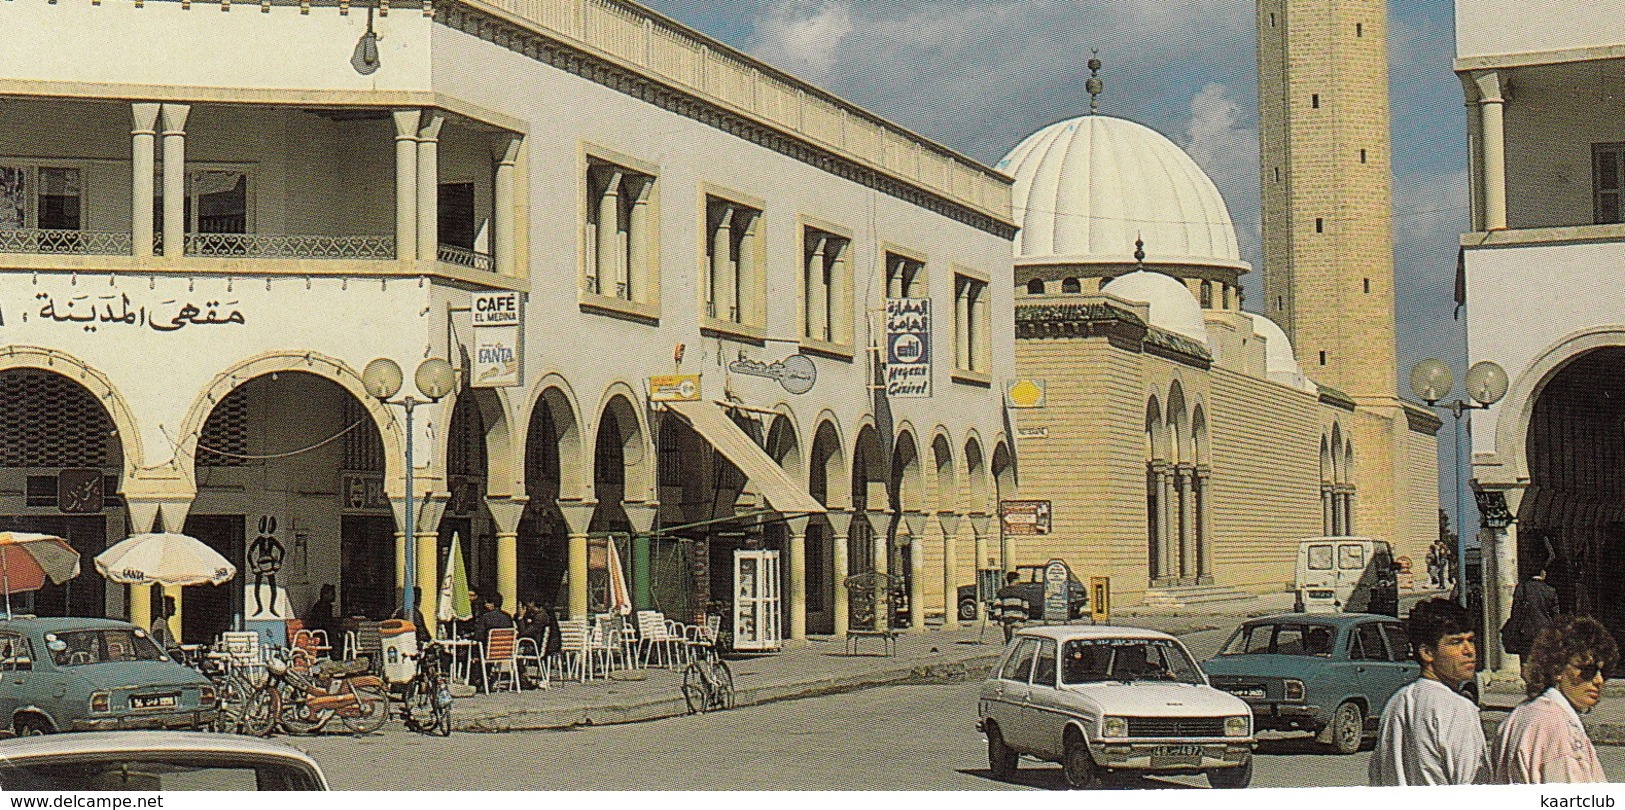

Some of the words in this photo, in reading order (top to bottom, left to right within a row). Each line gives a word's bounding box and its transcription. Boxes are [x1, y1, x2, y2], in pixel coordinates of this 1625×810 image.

[476, 293, 516, 311] CAFÉ
[475, 313, 484, 322] EL
[487, 312, 516, 322] MEDINA
[479, 347, 513, 363] FANTA
